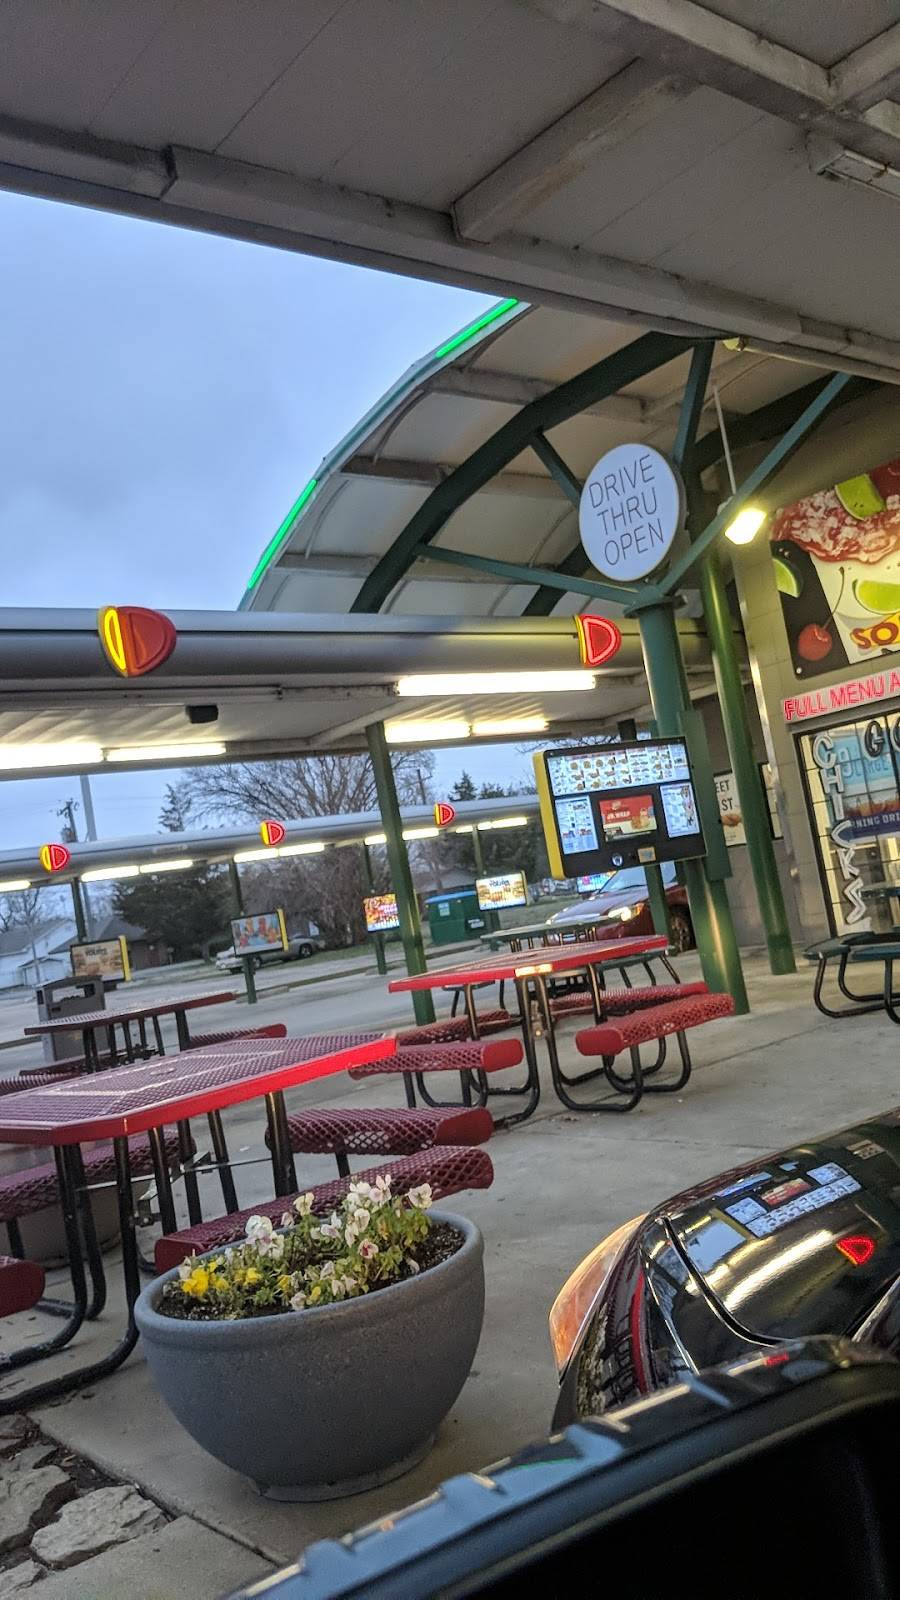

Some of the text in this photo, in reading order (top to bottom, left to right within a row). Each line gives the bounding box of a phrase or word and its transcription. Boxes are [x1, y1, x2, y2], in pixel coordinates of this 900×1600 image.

[588, 453, 655, 509] DRIVE
[597, 487, 658, 535] THRU
[604, 517, 664, 566] OPEN
[784, 693, 828, 720] FULL
[829, 675, 885, 708] MENU
